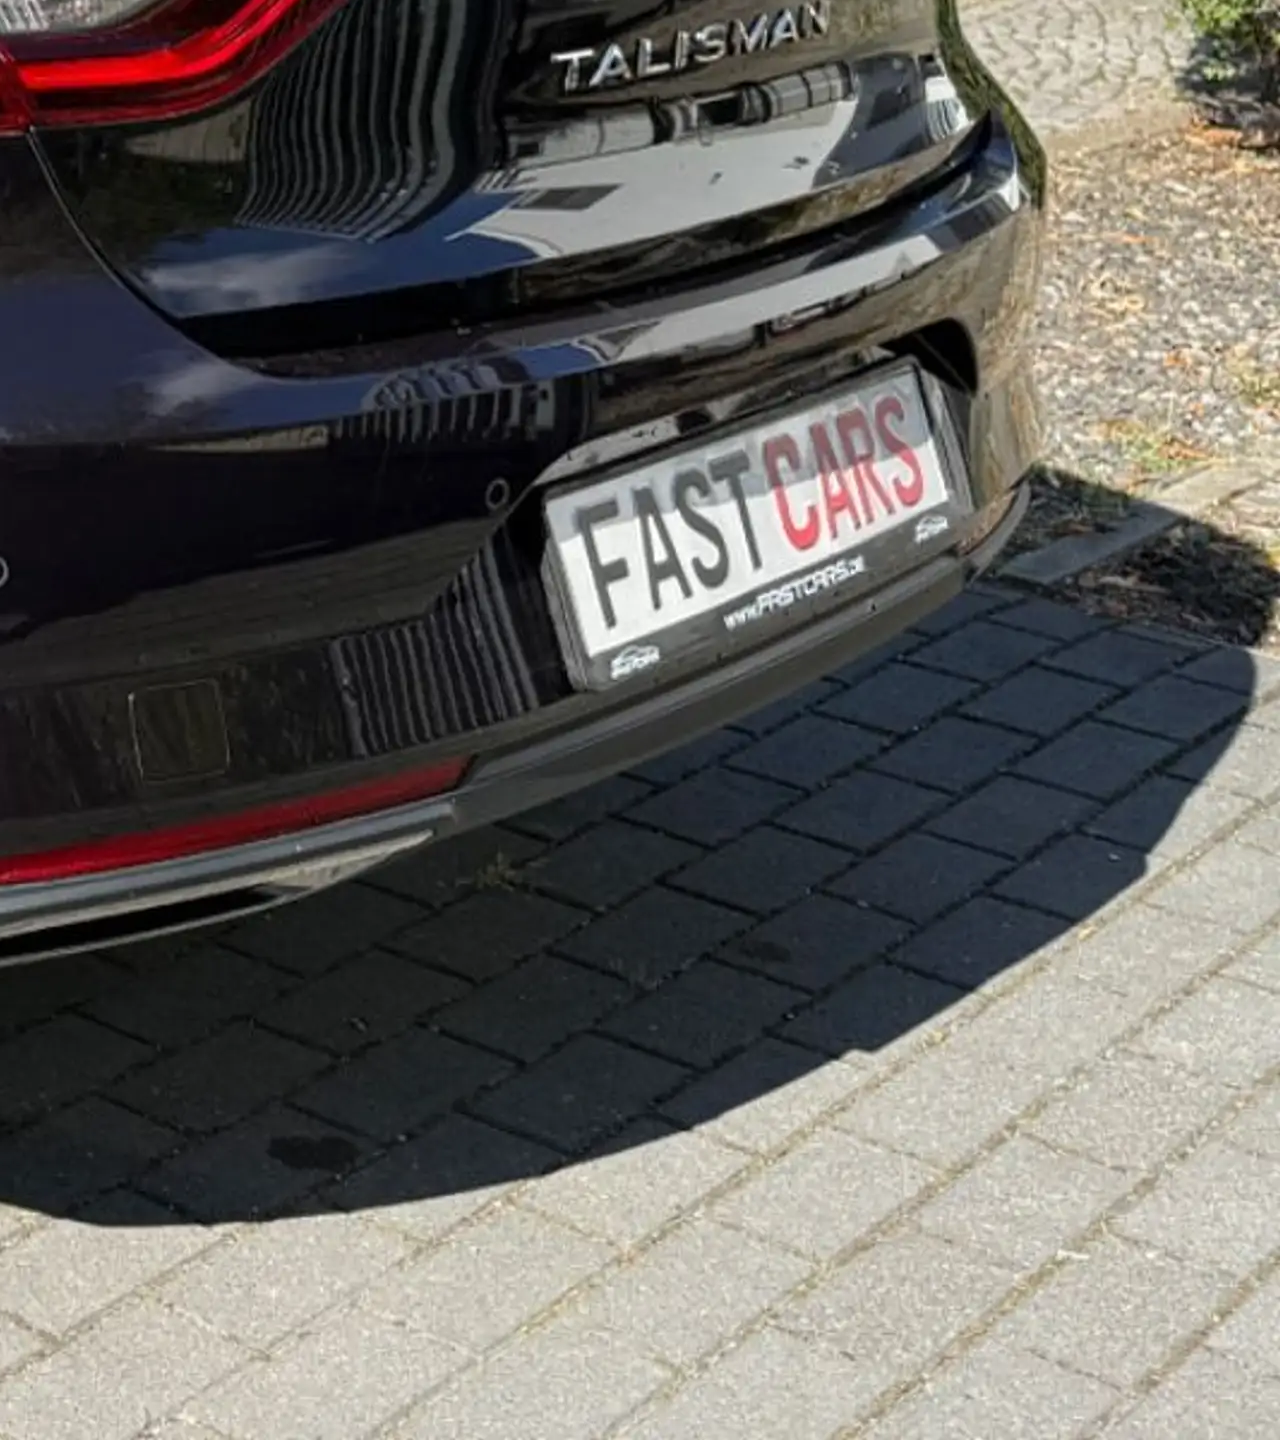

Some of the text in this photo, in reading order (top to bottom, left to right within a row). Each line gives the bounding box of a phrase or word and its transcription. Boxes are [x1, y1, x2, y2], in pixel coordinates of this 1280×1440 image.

[550, 0, 831, 91] TALISMAN
[575, 396, 924, 629] FAST CARS
